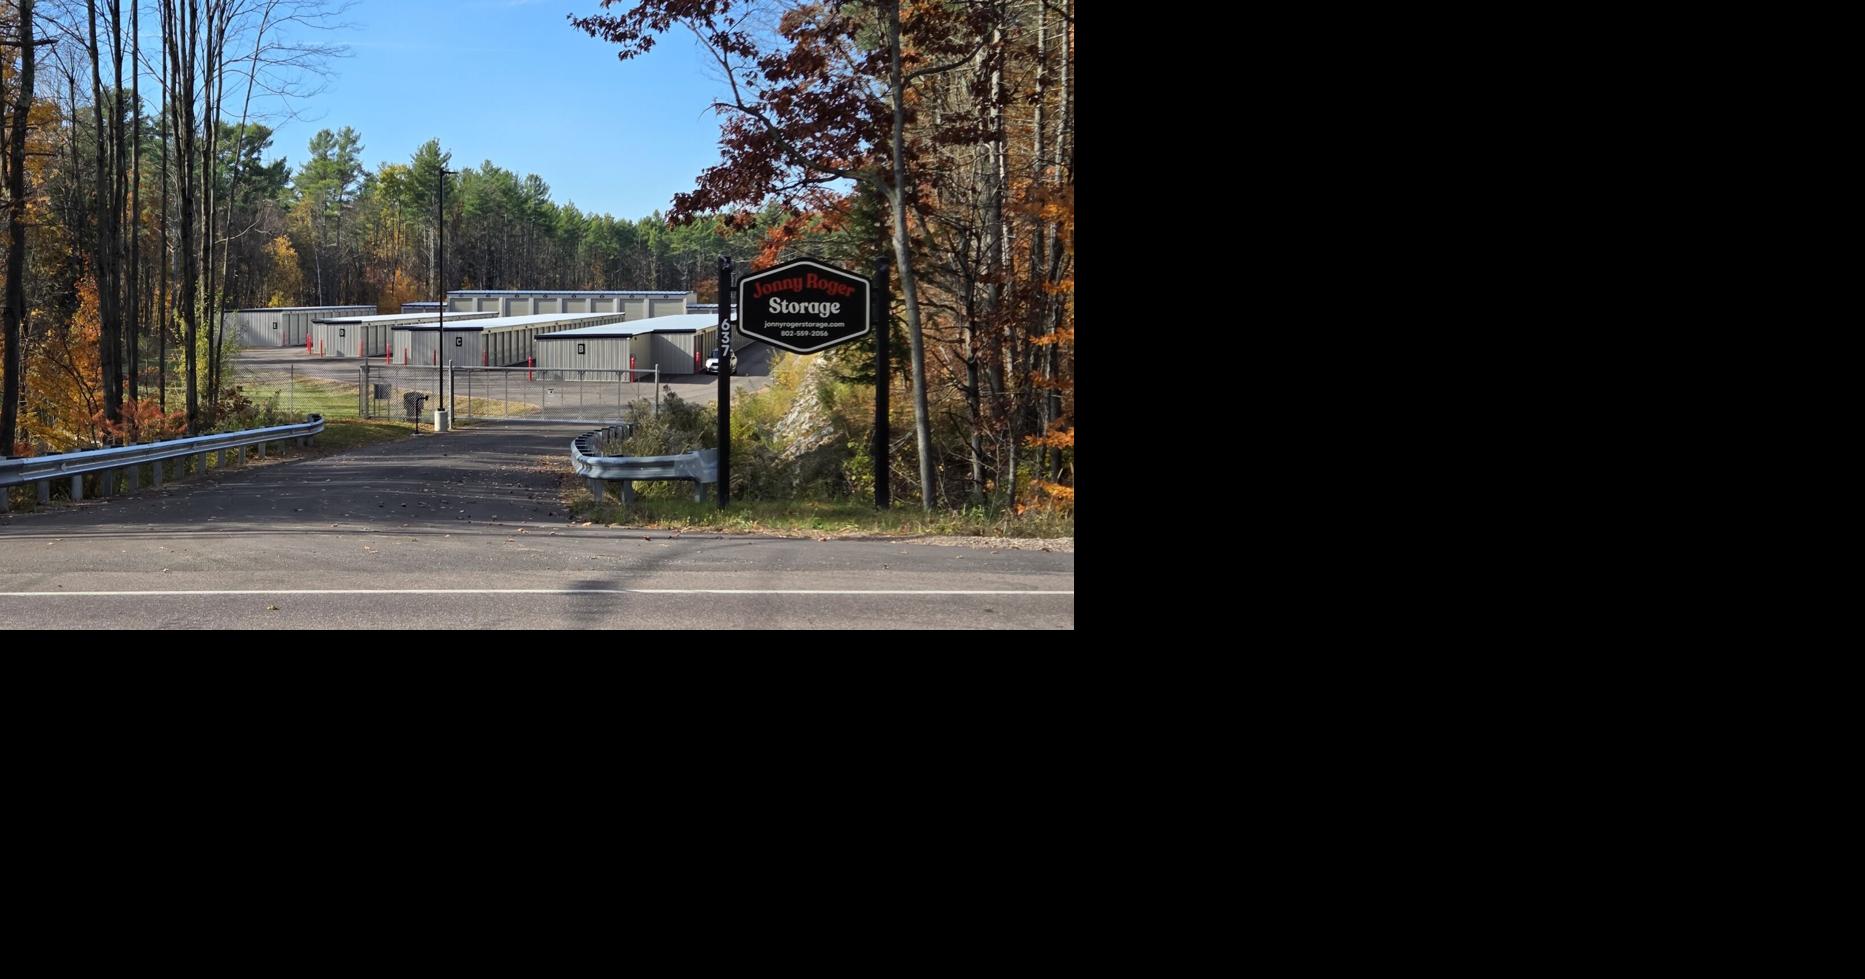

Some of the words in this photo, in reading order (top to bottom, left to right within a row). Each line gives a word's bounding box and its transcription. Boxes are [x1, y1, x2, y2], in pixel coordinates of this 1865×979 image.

[753, 275, 803, 298] Jonny
[806, 273, 855, 297] Roger
[769, 297, 840, 318] Storage
[764, 320, 845, 329] jonnyrogerstorage.com
[721, 318, 730, 357] 637
